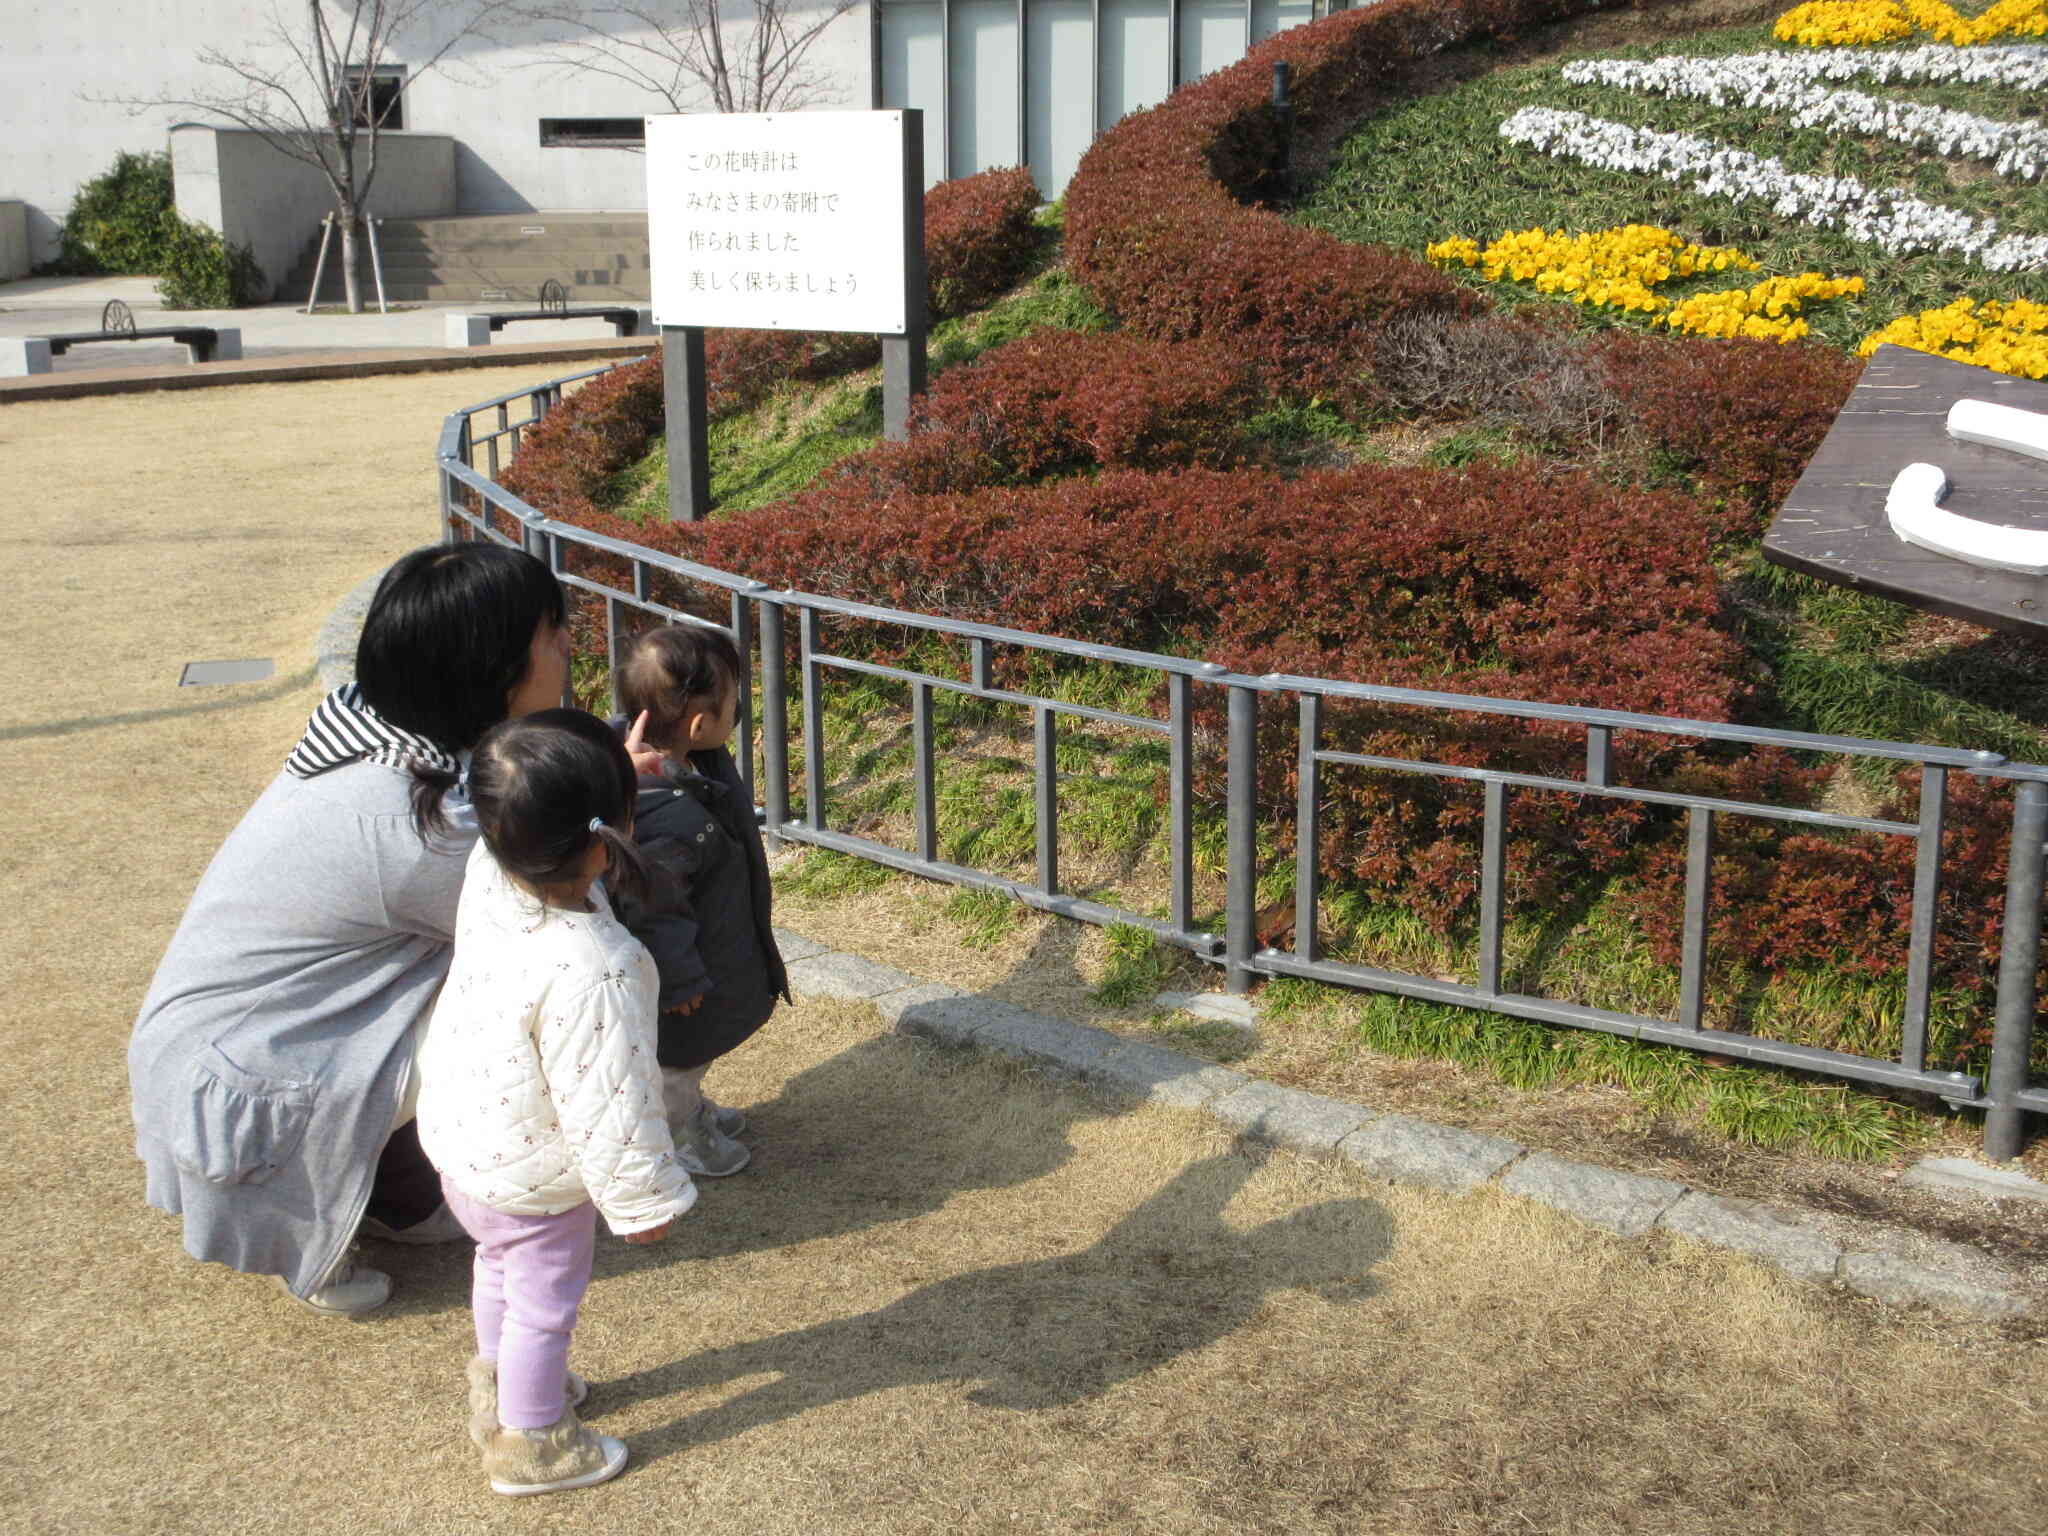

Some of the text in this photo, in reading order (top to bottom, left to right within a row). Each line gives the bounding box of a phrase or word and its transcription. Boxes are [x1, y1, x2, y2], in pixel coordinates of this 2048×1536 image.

[687, 151, 799, 172] この花時計は
[687, 191, 839, 213] みなさまの寄附で
[688, 230, 799, 252] 作られました
[689, 270, 858, 294] 美しく保ちましょう
